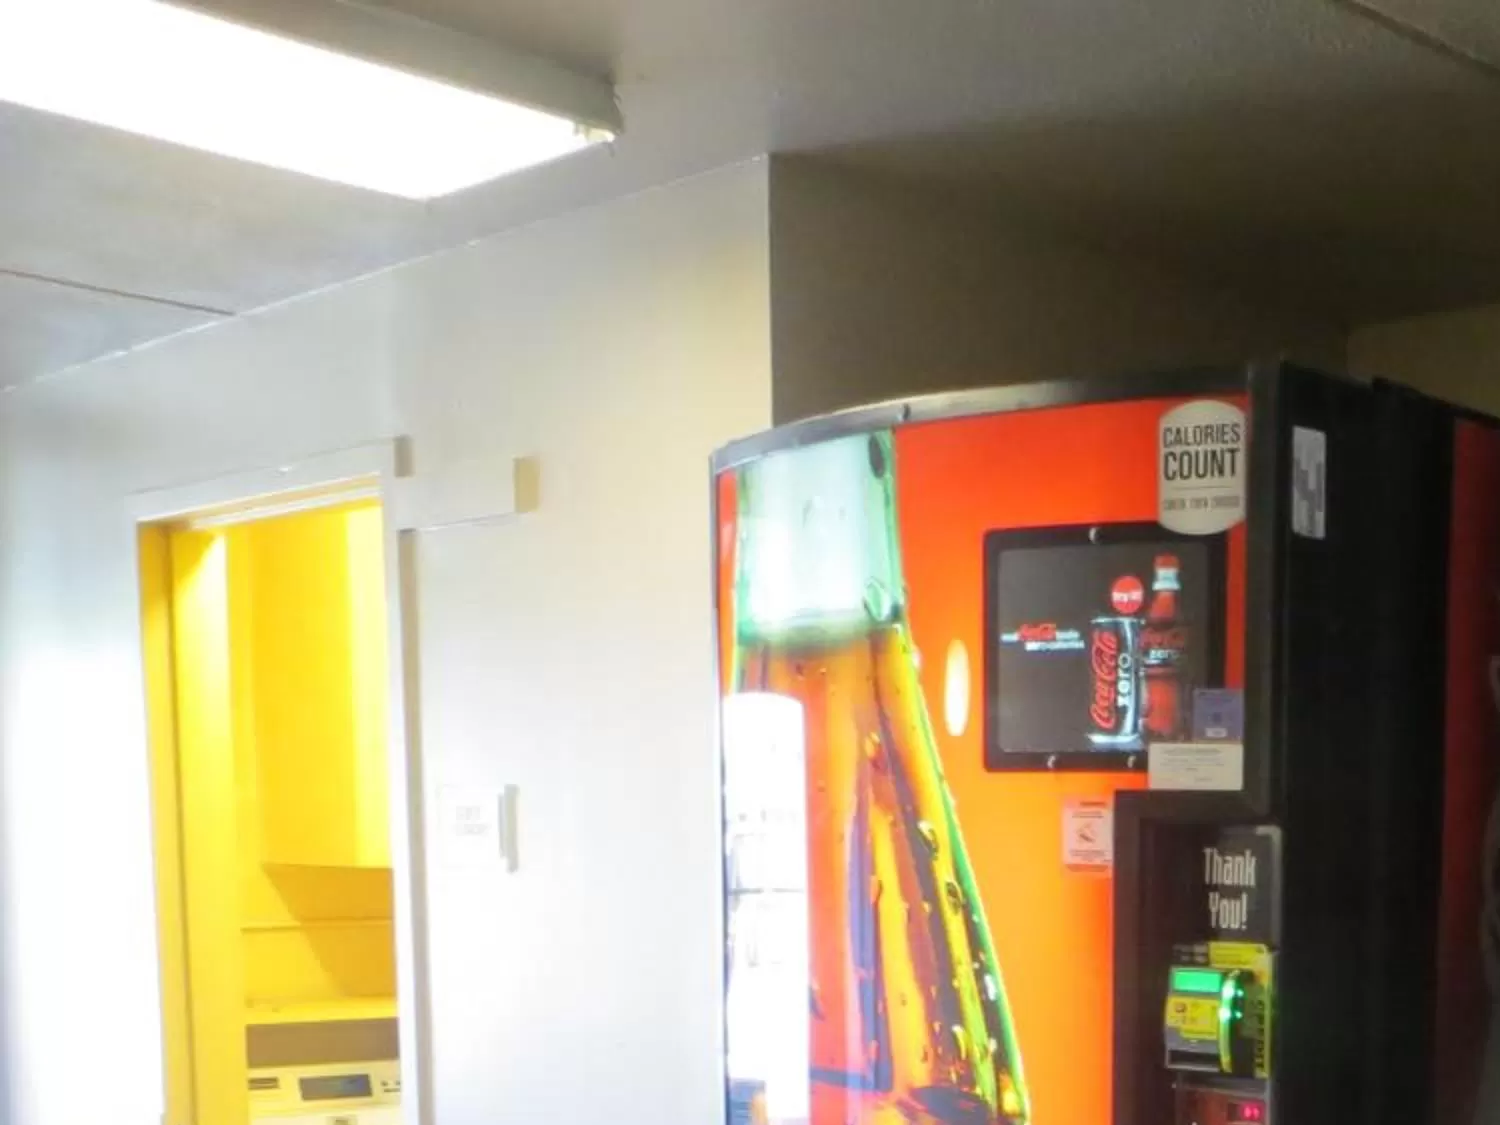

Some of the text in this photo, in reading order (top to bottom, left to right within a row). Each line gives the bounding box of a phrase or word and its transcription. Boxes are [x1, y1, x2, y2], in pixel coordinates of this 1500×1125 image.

[1162, 423, 1241, 449] CALORIES
[1163, 448, 1241, 481] COUNT
[1202, 847, 1256, 887] Thank
[1208, 891, 1248, 930] You!
